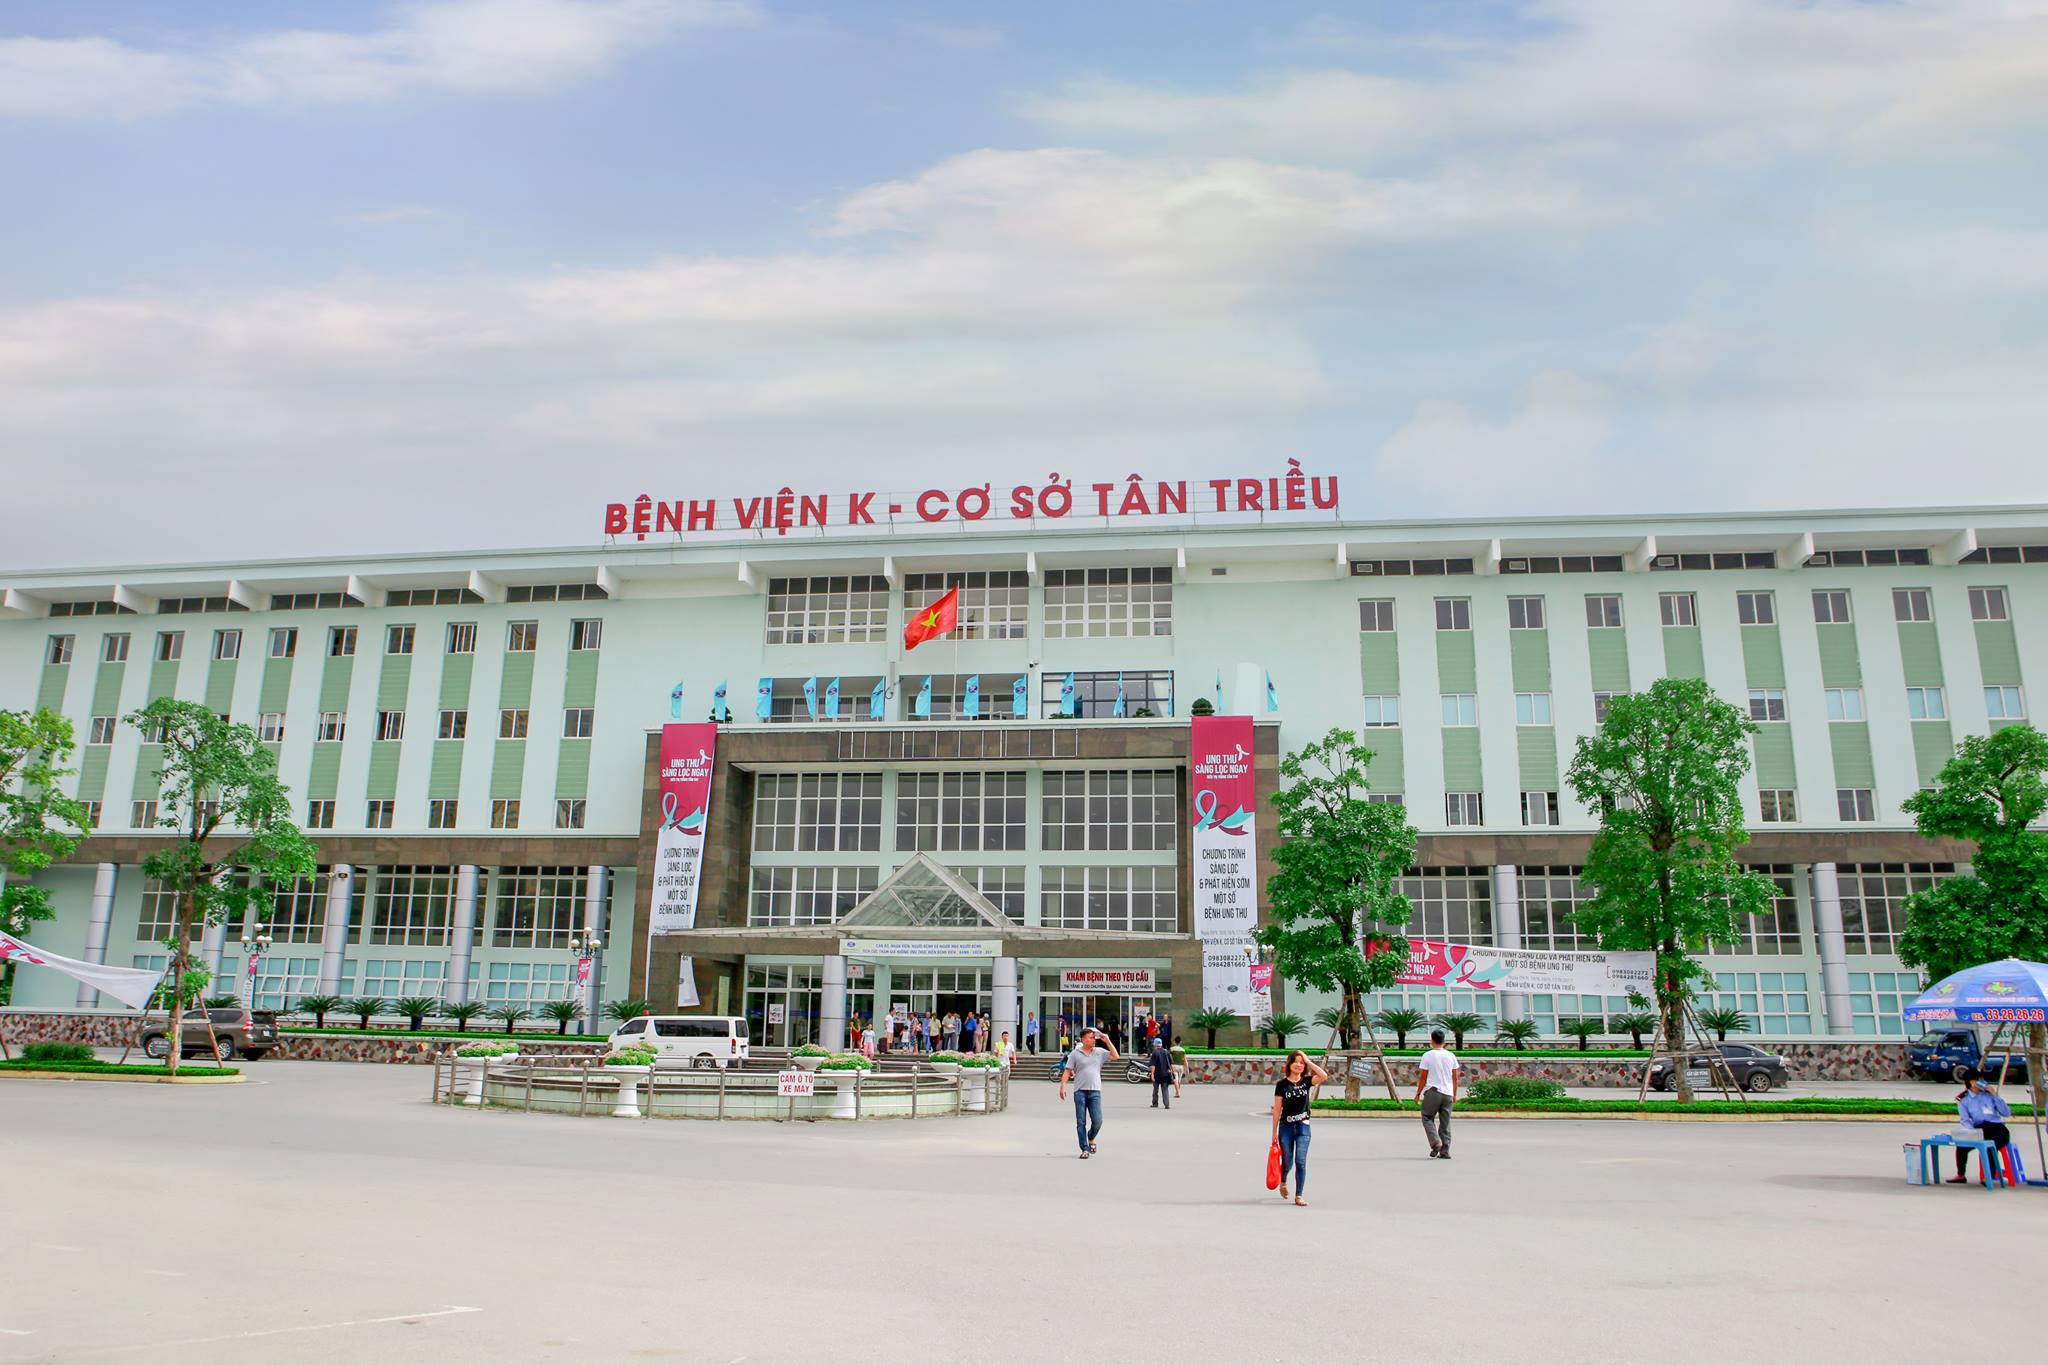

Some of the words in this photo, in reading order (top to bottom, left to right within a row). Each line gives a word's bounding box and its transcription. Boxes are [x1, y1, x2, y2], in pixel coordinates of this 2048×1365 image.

[605, 494, 716, 541] BỆNH
[733, 487, 828, 535] VIỆN
[849, 492, 876, 525] K
[916, 482, 991, 522] CƠ
[1010, 472, 1073, 518] SỞ
[1092, 474, 1187, 516] TÂN
[1209, 457, 1339, 512] TRIỀU
[1229, 764, 1249, 774] NGAY
[1414, 964, 1435, 976] NGAY
[1105, 972, 1121, 982] THEO
[1986, 1008, 2045, 1020] 33.26.26.26
[783, 1085, 792, 1093] XE
